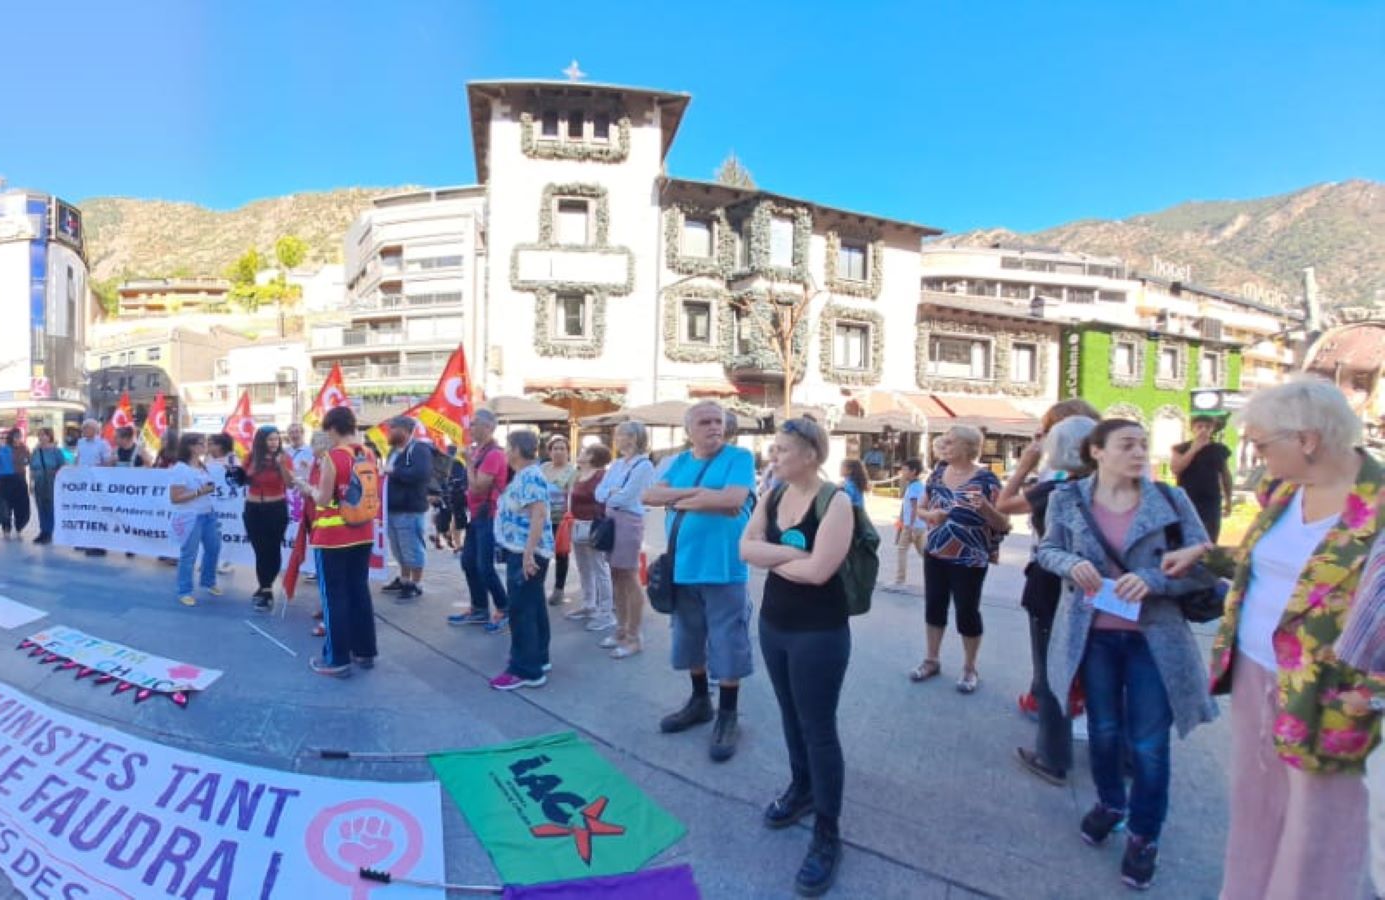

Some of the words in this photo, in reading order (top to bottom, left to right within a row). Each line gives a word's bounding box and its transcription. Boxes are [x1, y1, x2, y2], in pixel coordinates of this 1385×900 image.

[108, 483, 148, 497] DROIT
[122, 523, 168, 539] Vaness
[155, 763, 301, 838] TANT
[18, 773, 238, 900] FAUDRA
